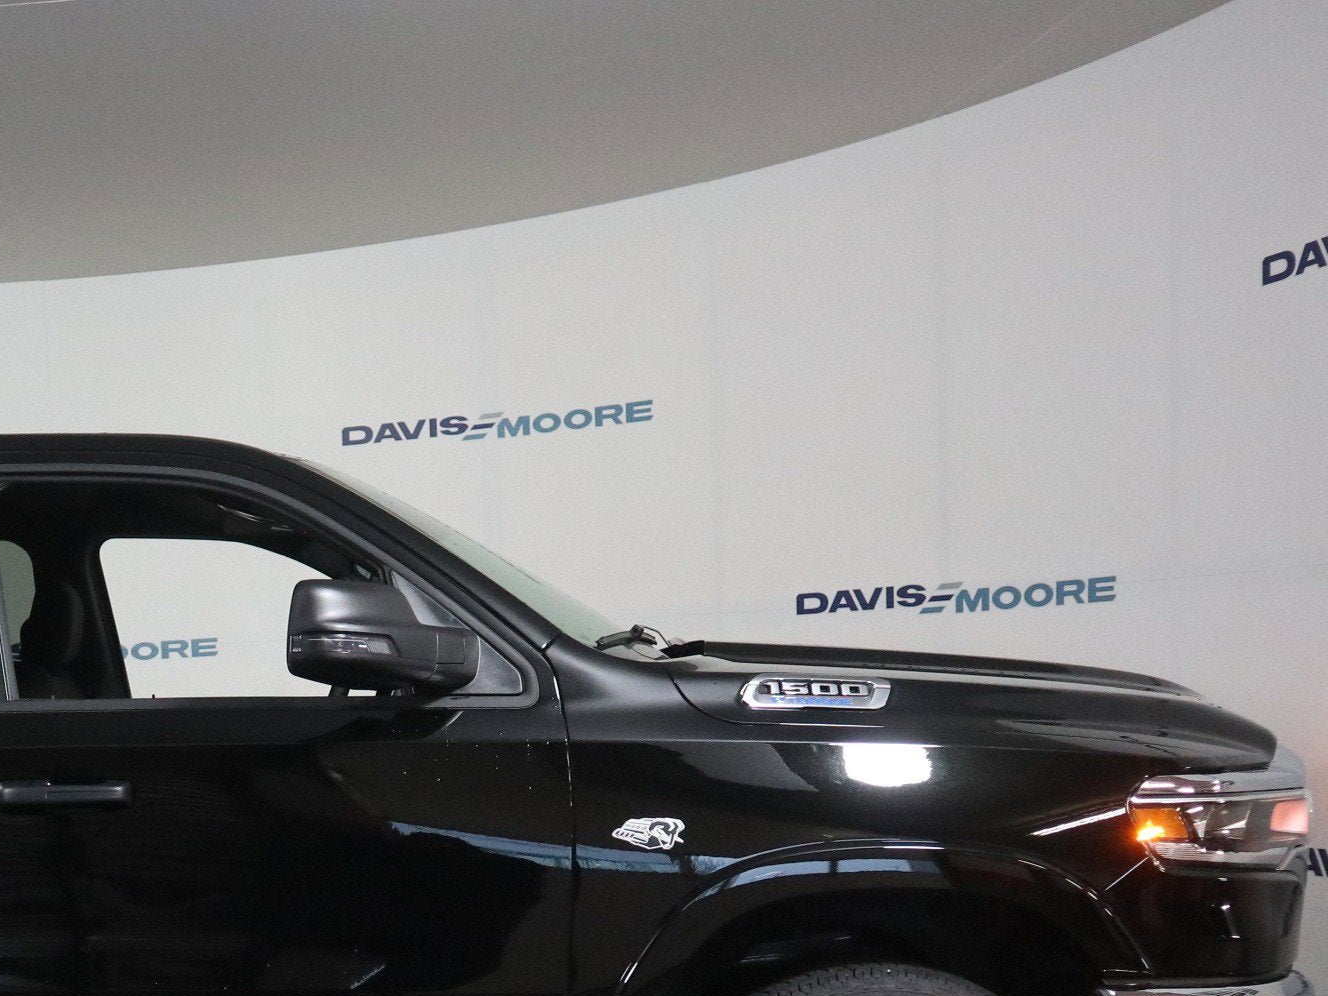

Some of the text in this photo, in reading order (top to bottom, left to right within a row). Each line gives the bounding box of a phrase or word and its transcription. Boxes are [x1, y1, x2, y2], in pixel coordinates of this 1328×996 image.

[1262, 236, 1328, 285] DA
[342, 400, 654, 446] DAVIS MOORE
[796, 576, 1117, 615] DAVIS MOORE
[765, 681, 870, 696] 1500
